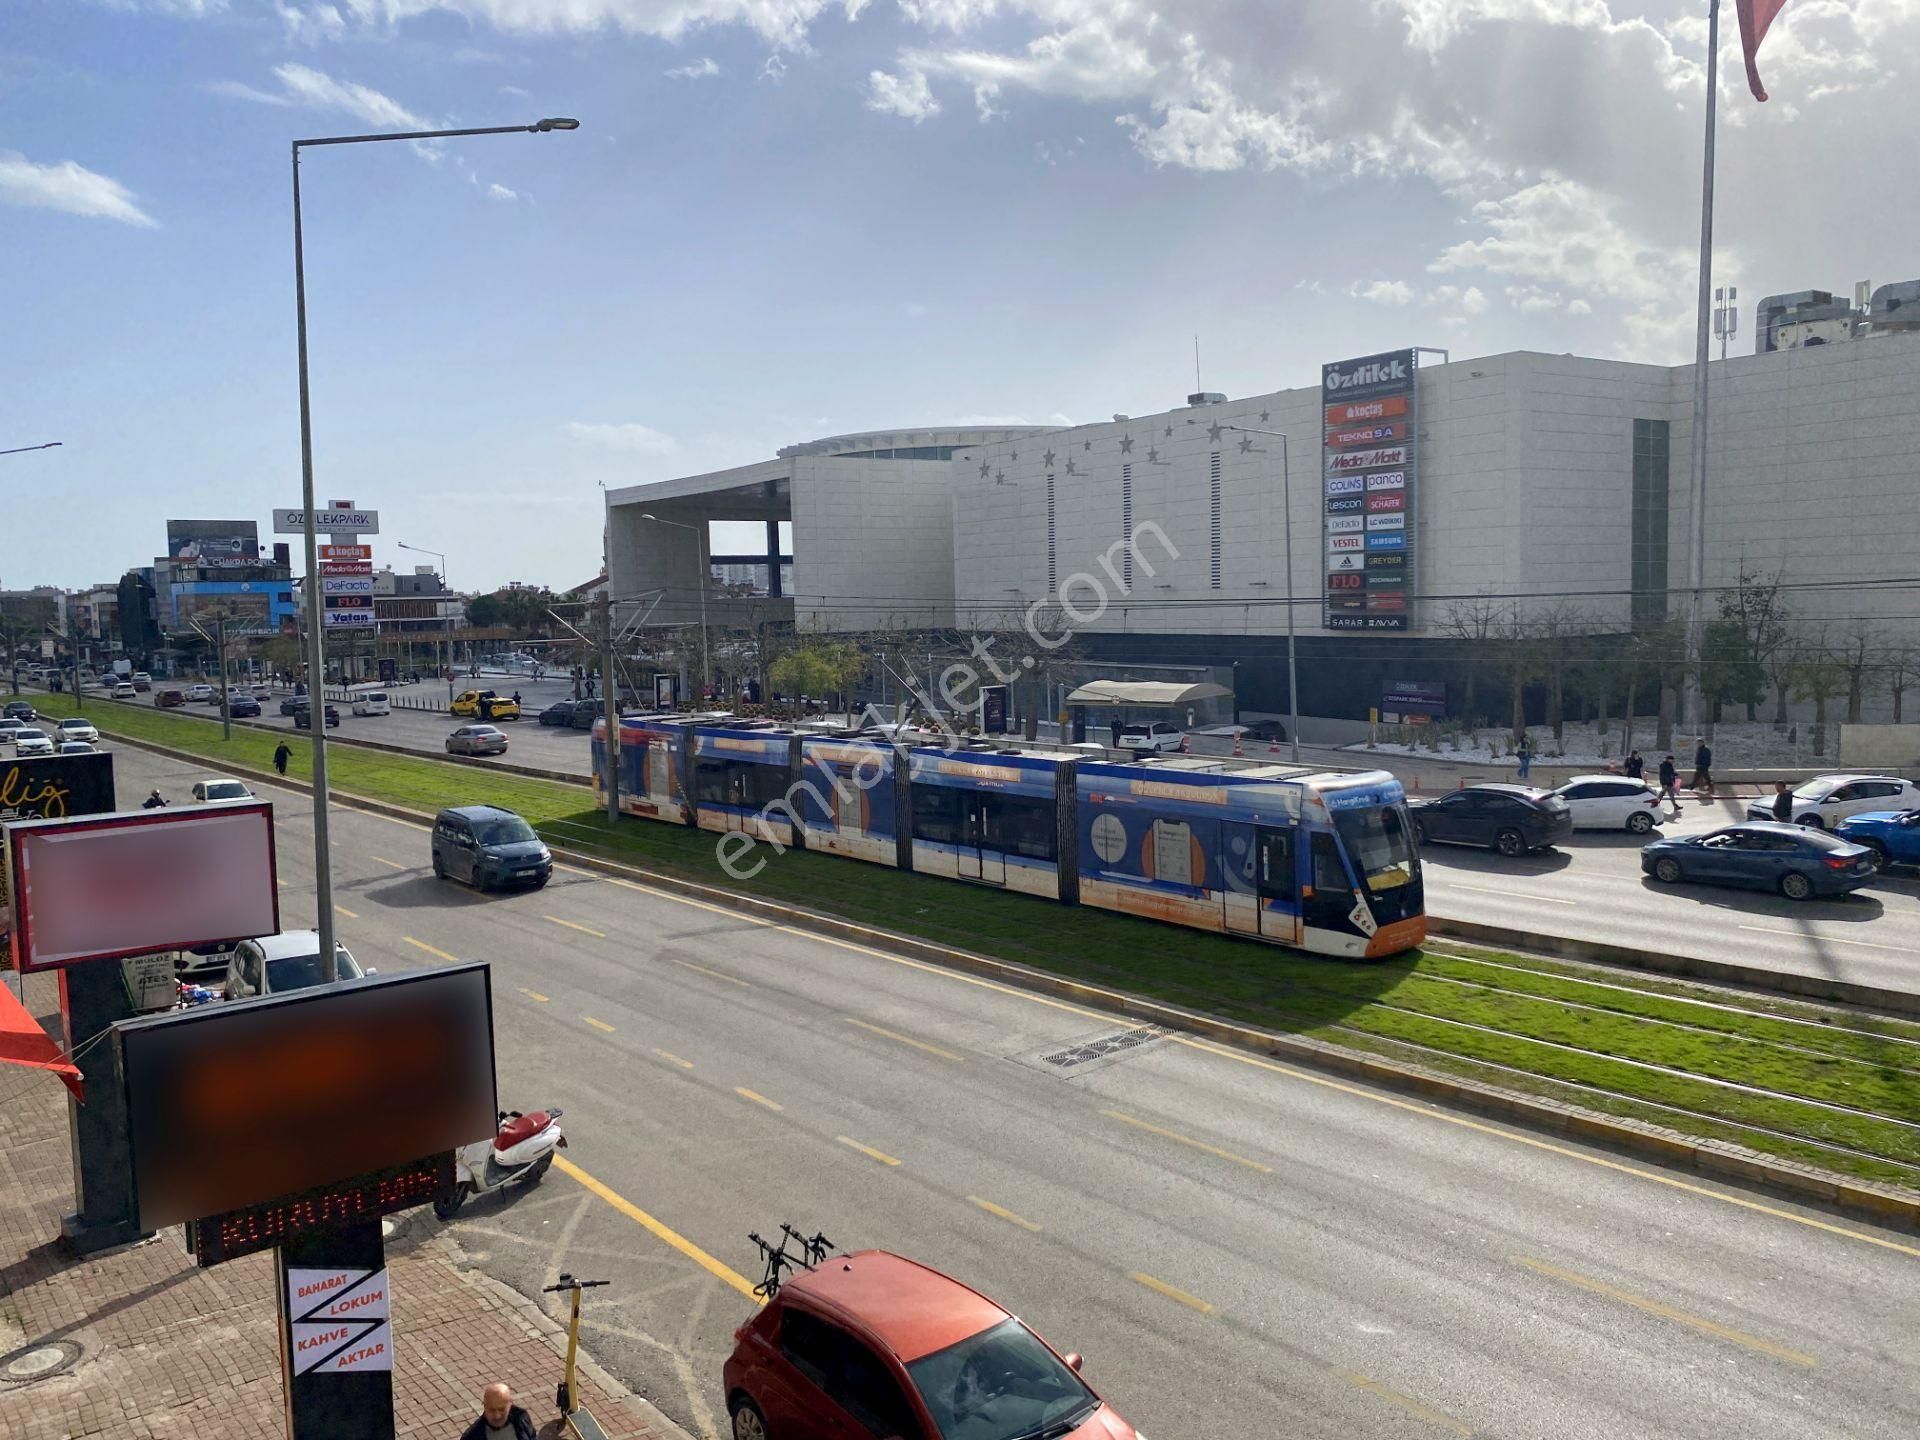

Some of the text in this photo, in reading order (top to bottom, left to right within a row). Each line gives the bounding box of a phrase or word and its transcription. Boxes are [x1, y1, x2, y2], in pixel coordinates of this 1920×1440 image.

[1326, 360, 1407, 390] Özdilek
[1354, 403, 1383, 417] koçtaş
[1330, 450, 1402, 469] Media Markt
[1368, 473, 1403, 487] panco
[287, 512, 370, 524] ÖZLEKPARK
[1333, 538, 1360, 548] VESTEL
[1370, 537, 1402, 545] SAMSUNG
[335, 547, 364, 558] koçtaş
[212, 558, 247, 566] CHAKRA
[326, 580, 370, 590] DeFacto
[1331, 575, 1361, 588] FLO
[337, 597, 361, 607] FLO
[332, 613, 368, 622] Vatan
[1332, 619, 1363, 627] SARAR
[298, 1274, 348, 1298] BAHARAT
[330, 1290, 383, 1315] LOKUM
[298, 1327, 348, 1351] KAHVE
[338, 1343, 384, 1368] AKTAR
